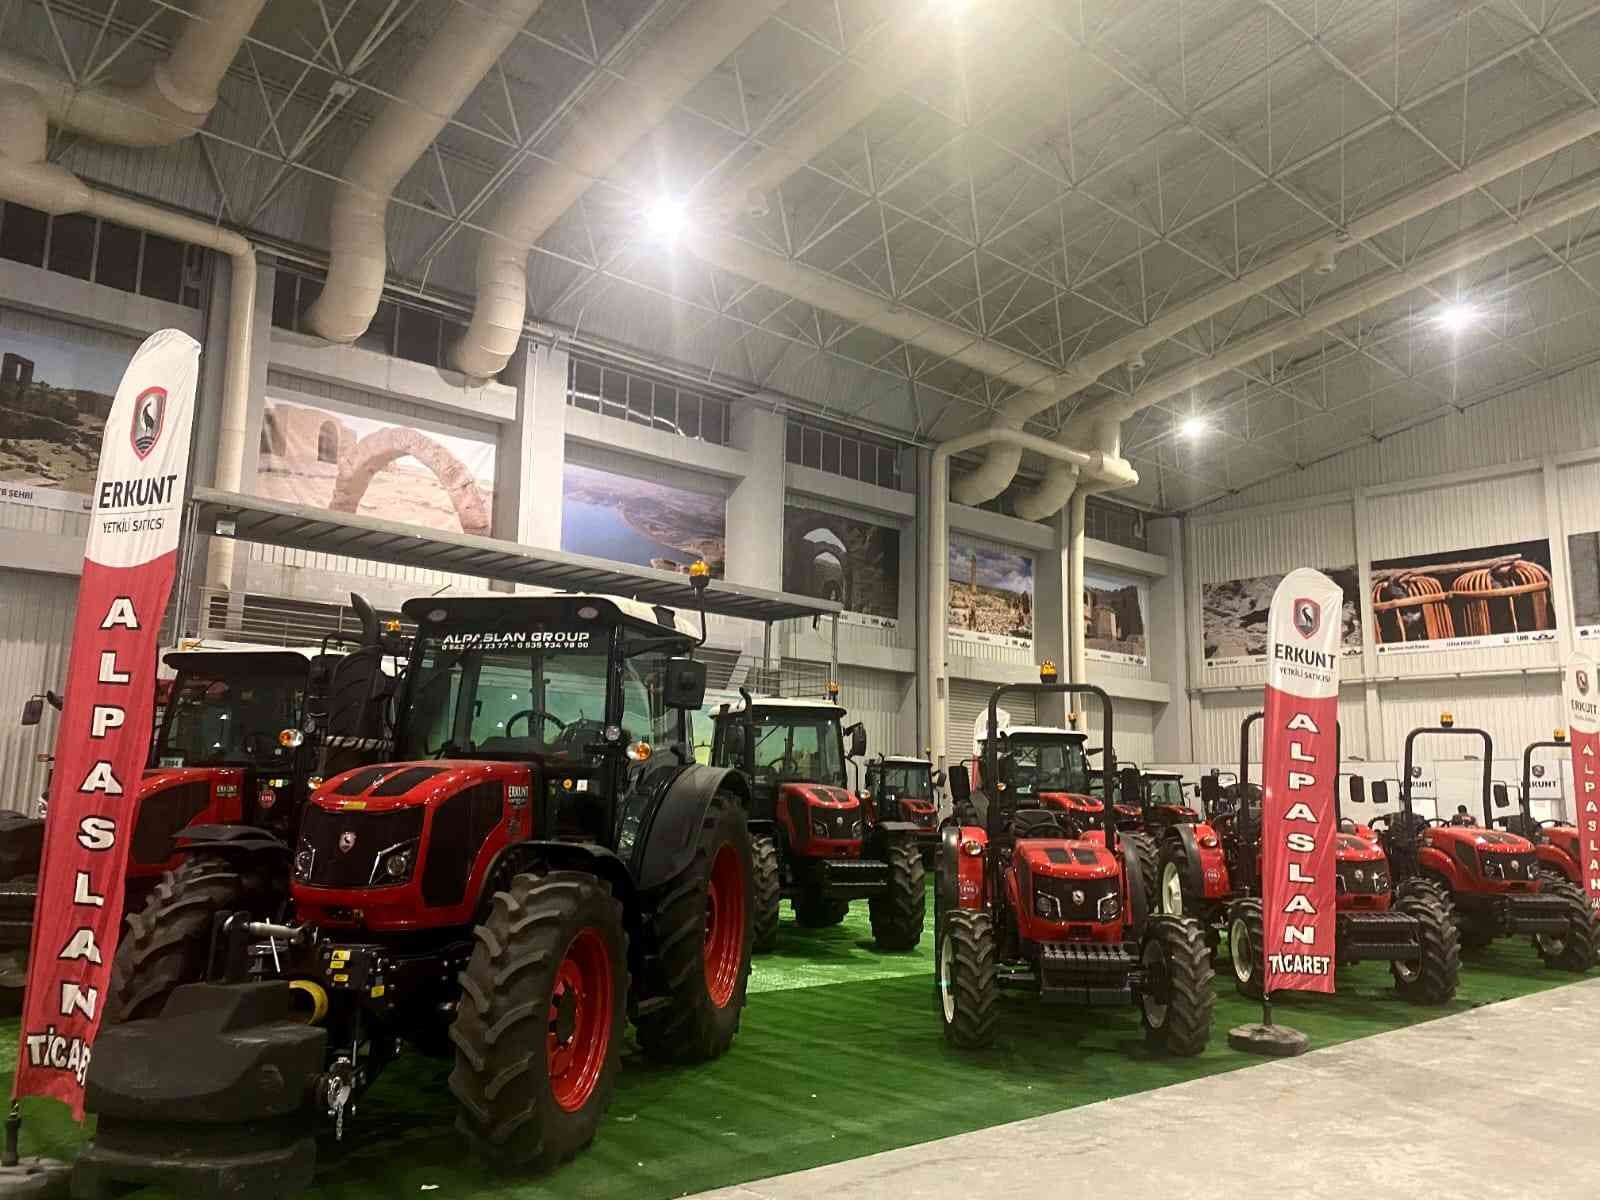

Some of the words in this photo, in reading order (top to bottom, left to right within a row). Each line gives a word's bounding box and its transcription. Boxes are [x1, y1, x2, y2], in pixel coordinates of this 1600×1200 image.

[98, 474, 178, 509] ERKUNT
[103, 518, 132, 535] YETKİLİ
[443, 632, 526, 644] ALPASLAN
[531, 632, 590, 642] GROUP
[1274, 643, 1336, 669] ERKUNT
[1521, 780, 1556, 788] KUNT
[59, 595, 140, 1022] ALPASLAN
[1582, 743, 1600, 891] ALPASLAN
[1283, 712, 1320, 944] ALPASLAN
[1268, 952, 1330, 976] TİCARET
